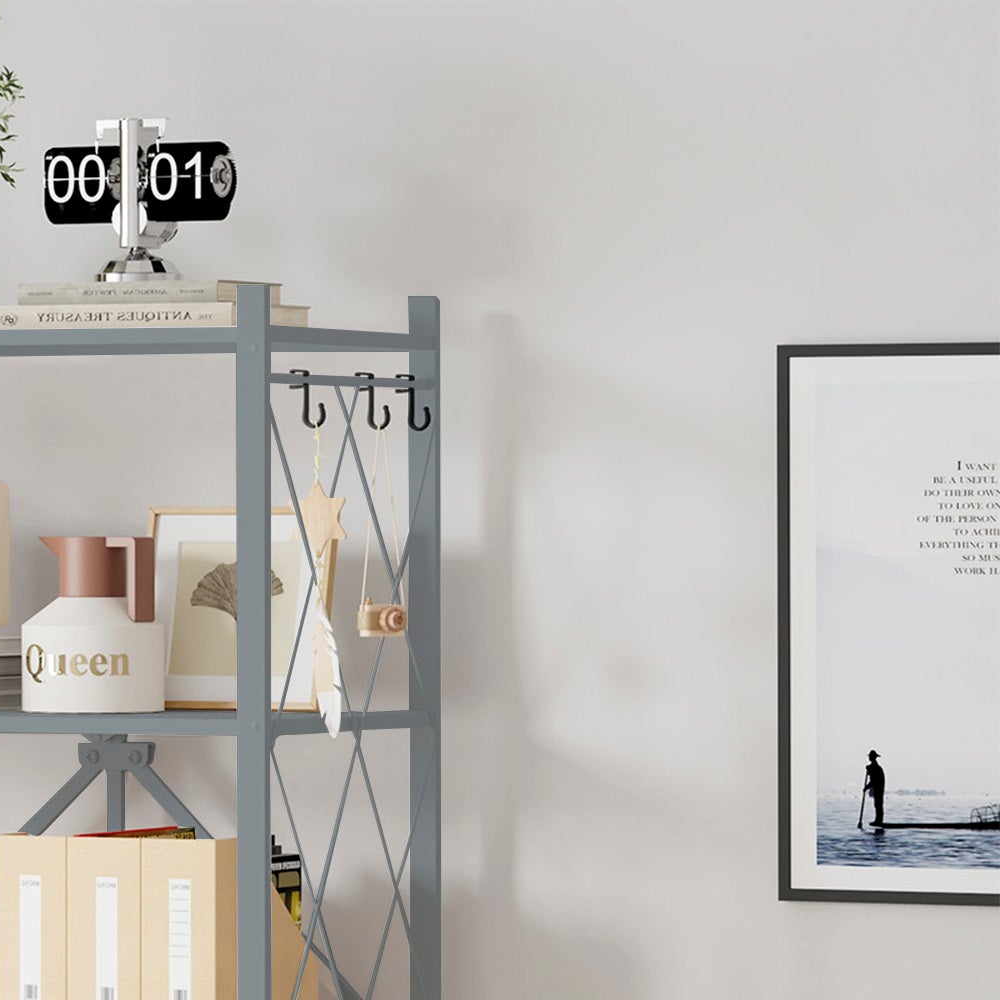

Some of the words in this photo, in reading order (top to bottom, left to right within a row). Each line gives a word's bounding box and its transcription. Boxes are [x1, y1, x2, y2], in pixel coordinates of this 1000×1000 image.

[47, 154, 106, 203] 00
[150, 151, 202, 201] 01
[965, 463, 997, 471] WANT
[954, 567, 986, 575] WORK
[26, 643, 131, 684] Queen
